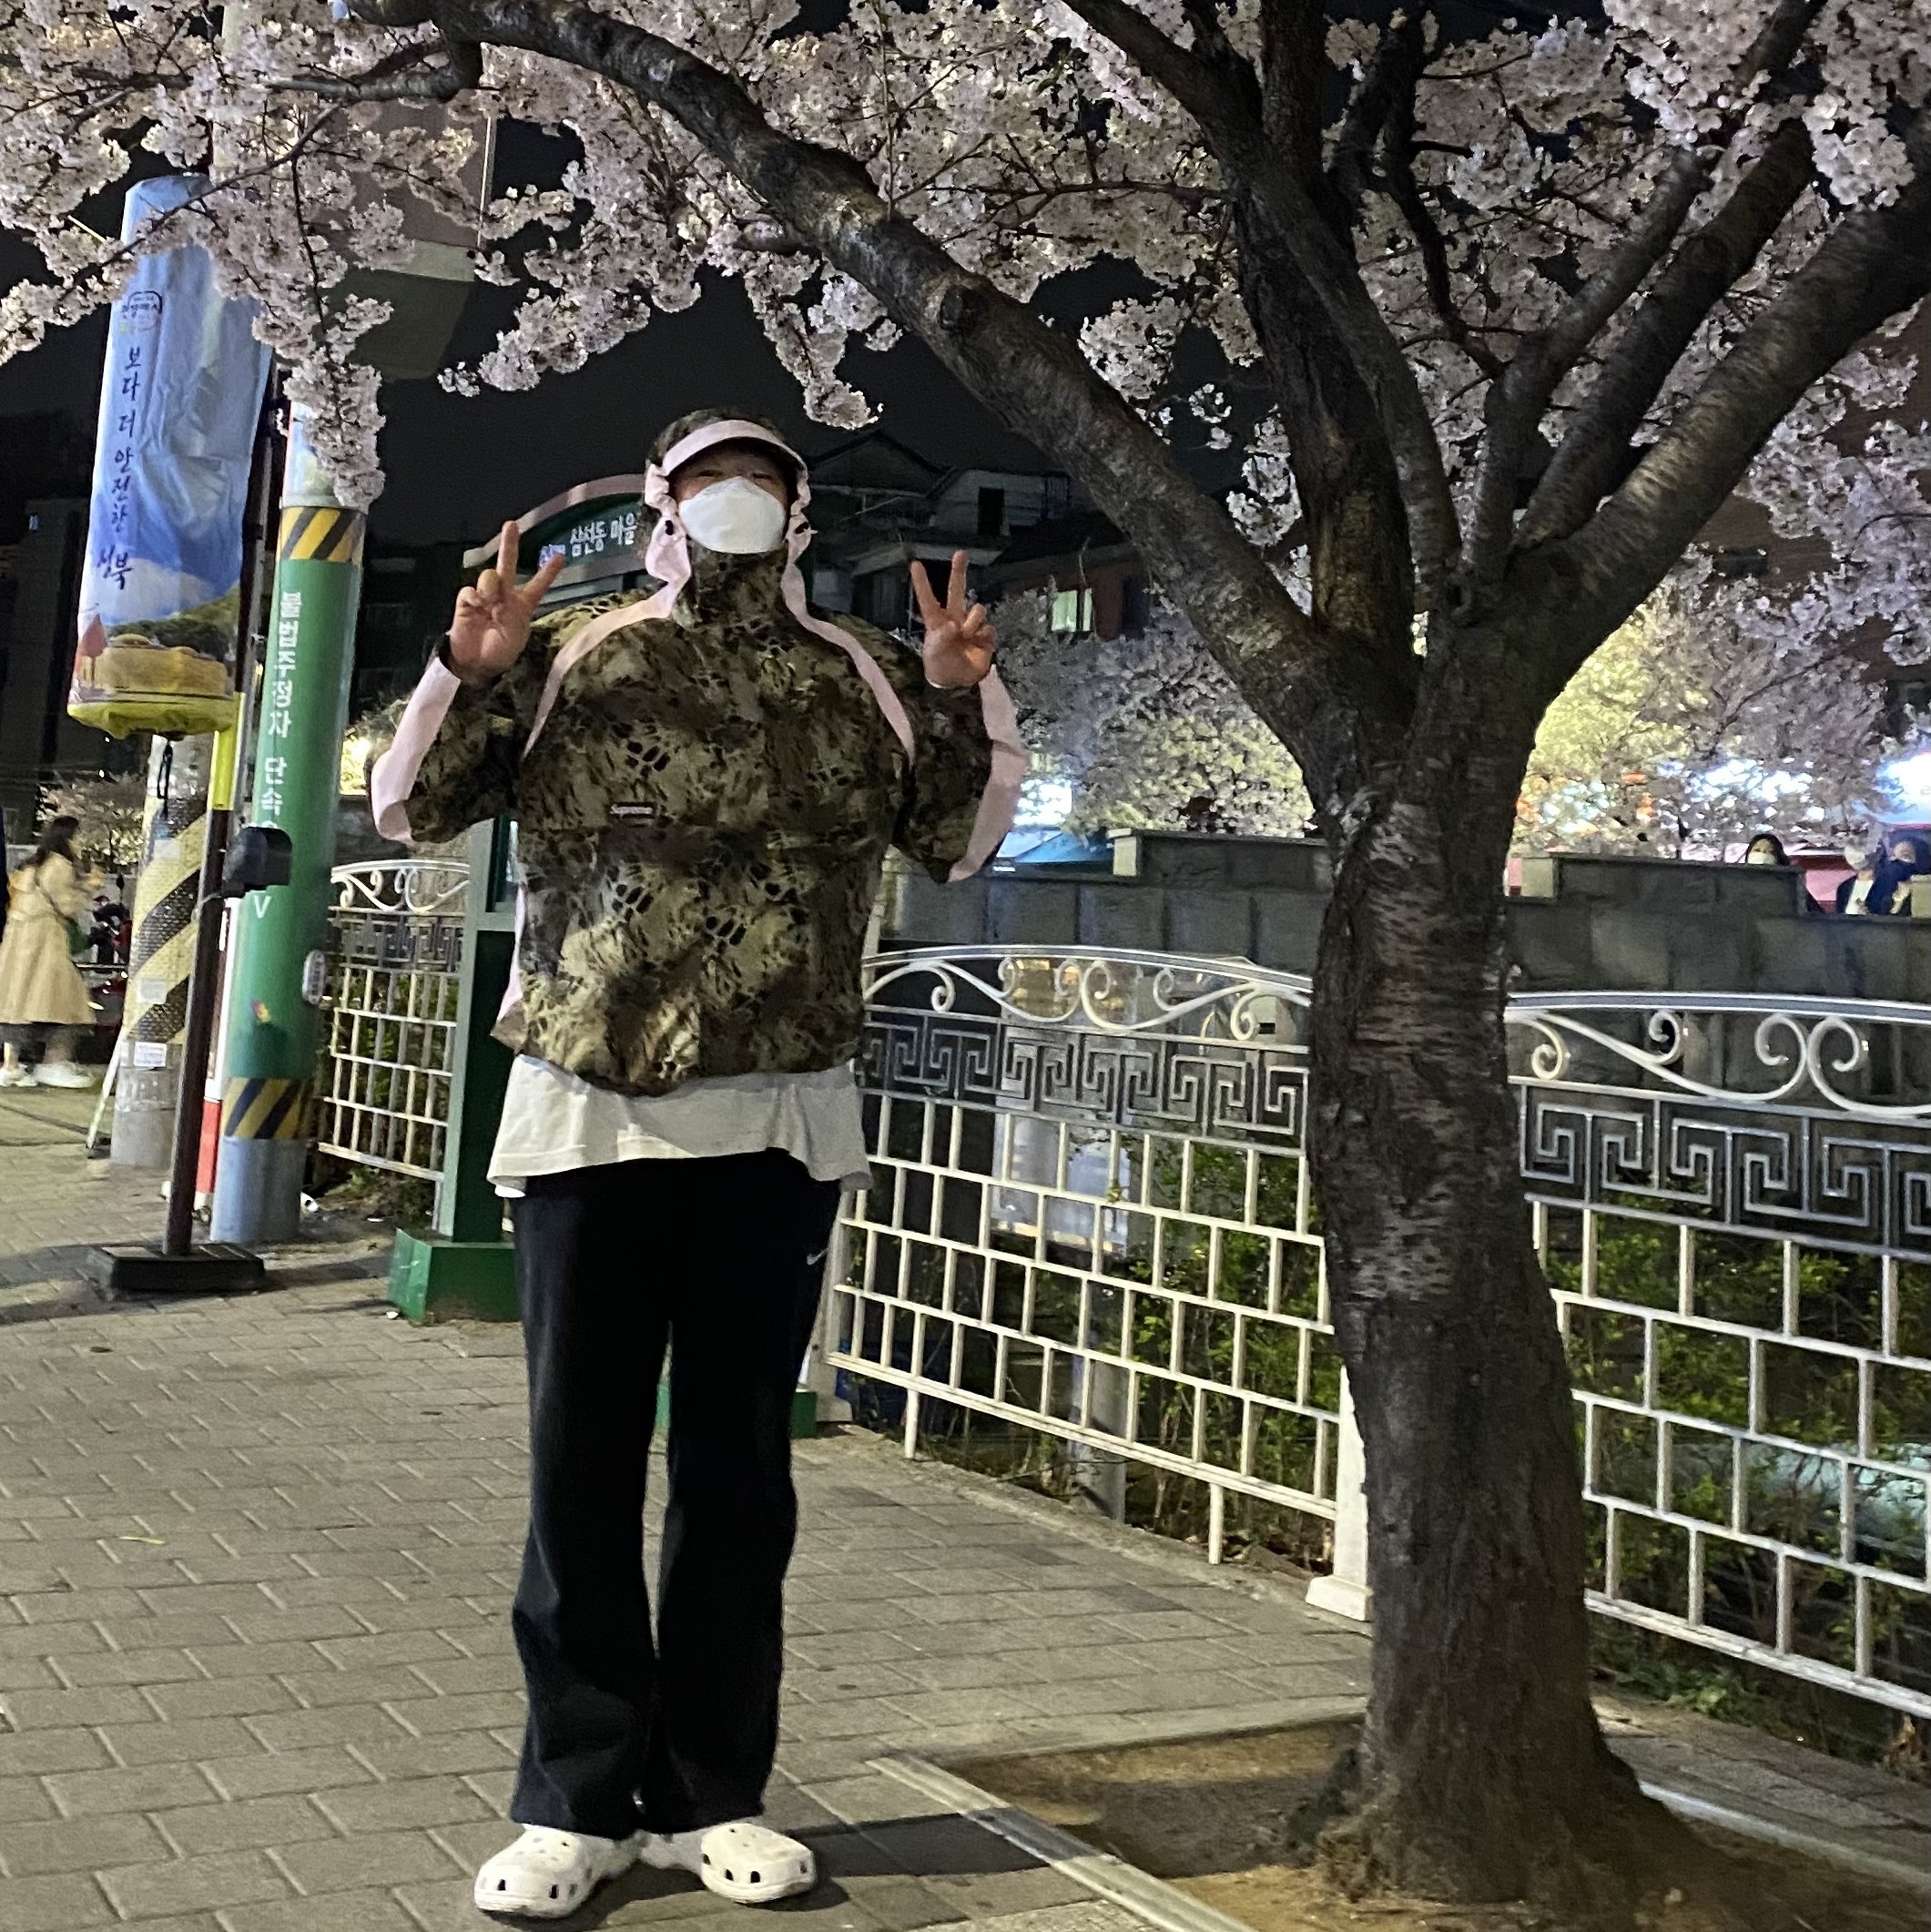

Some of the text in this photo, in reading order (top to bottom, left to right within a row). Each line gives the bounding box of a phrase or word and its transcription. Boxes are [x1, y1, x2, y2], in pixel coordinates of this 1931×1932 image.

[111, 346, 141, 533] 보다 더 안전한
[260, 756, 288, 817] 단속
